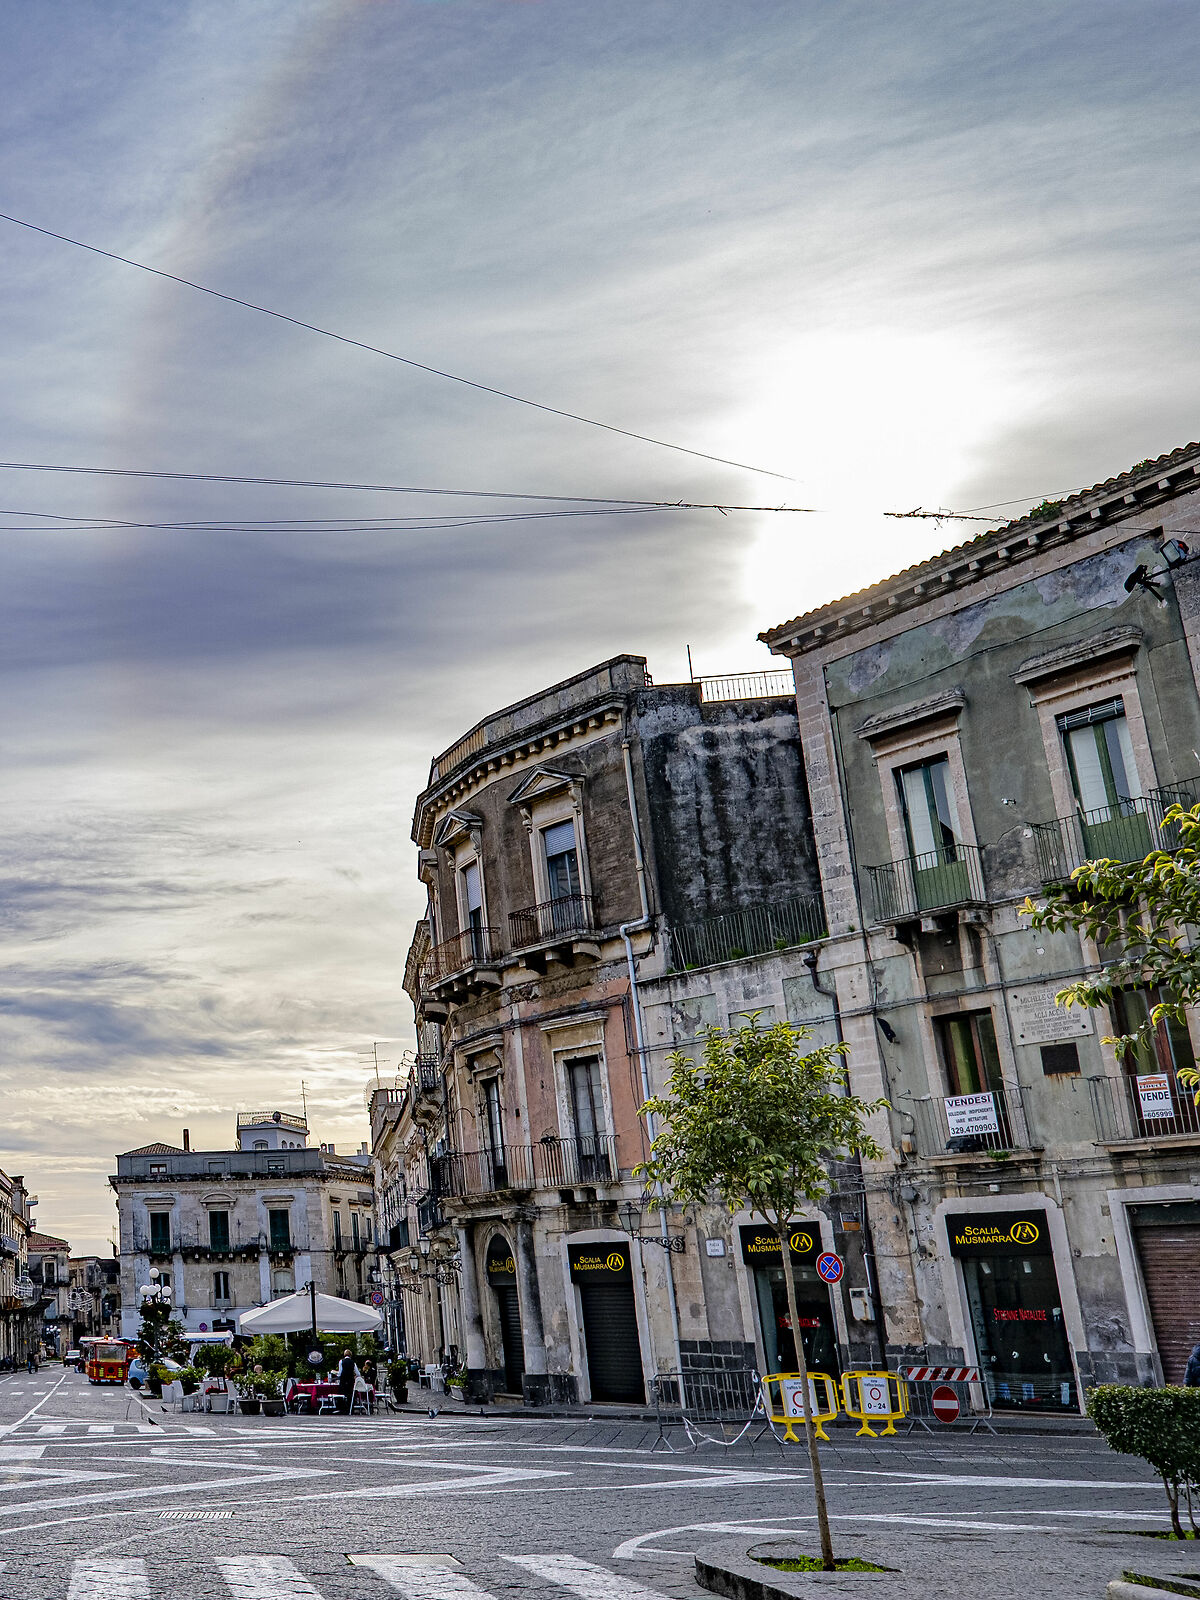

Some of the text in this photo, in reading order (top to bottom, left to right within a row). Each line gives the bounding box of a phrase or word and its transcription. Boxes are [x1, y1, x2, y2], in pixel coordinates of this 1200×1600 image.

[947, 1095, 991, 1107] VENDESI
[1140, 1091, 1170, 1102] VENDE
[951, 1123, 998, 1135] 329.4709903
[964, 1226, 1000, 1236] SCALIA
[955, 1235, 1013, 1245] MUSMARRA
[579, 1256, 602, 1264] SCALIA
[573, 1263, 609, 1271] MUSMARRA
[993, 1308, 1019, 1321] STRENNE
